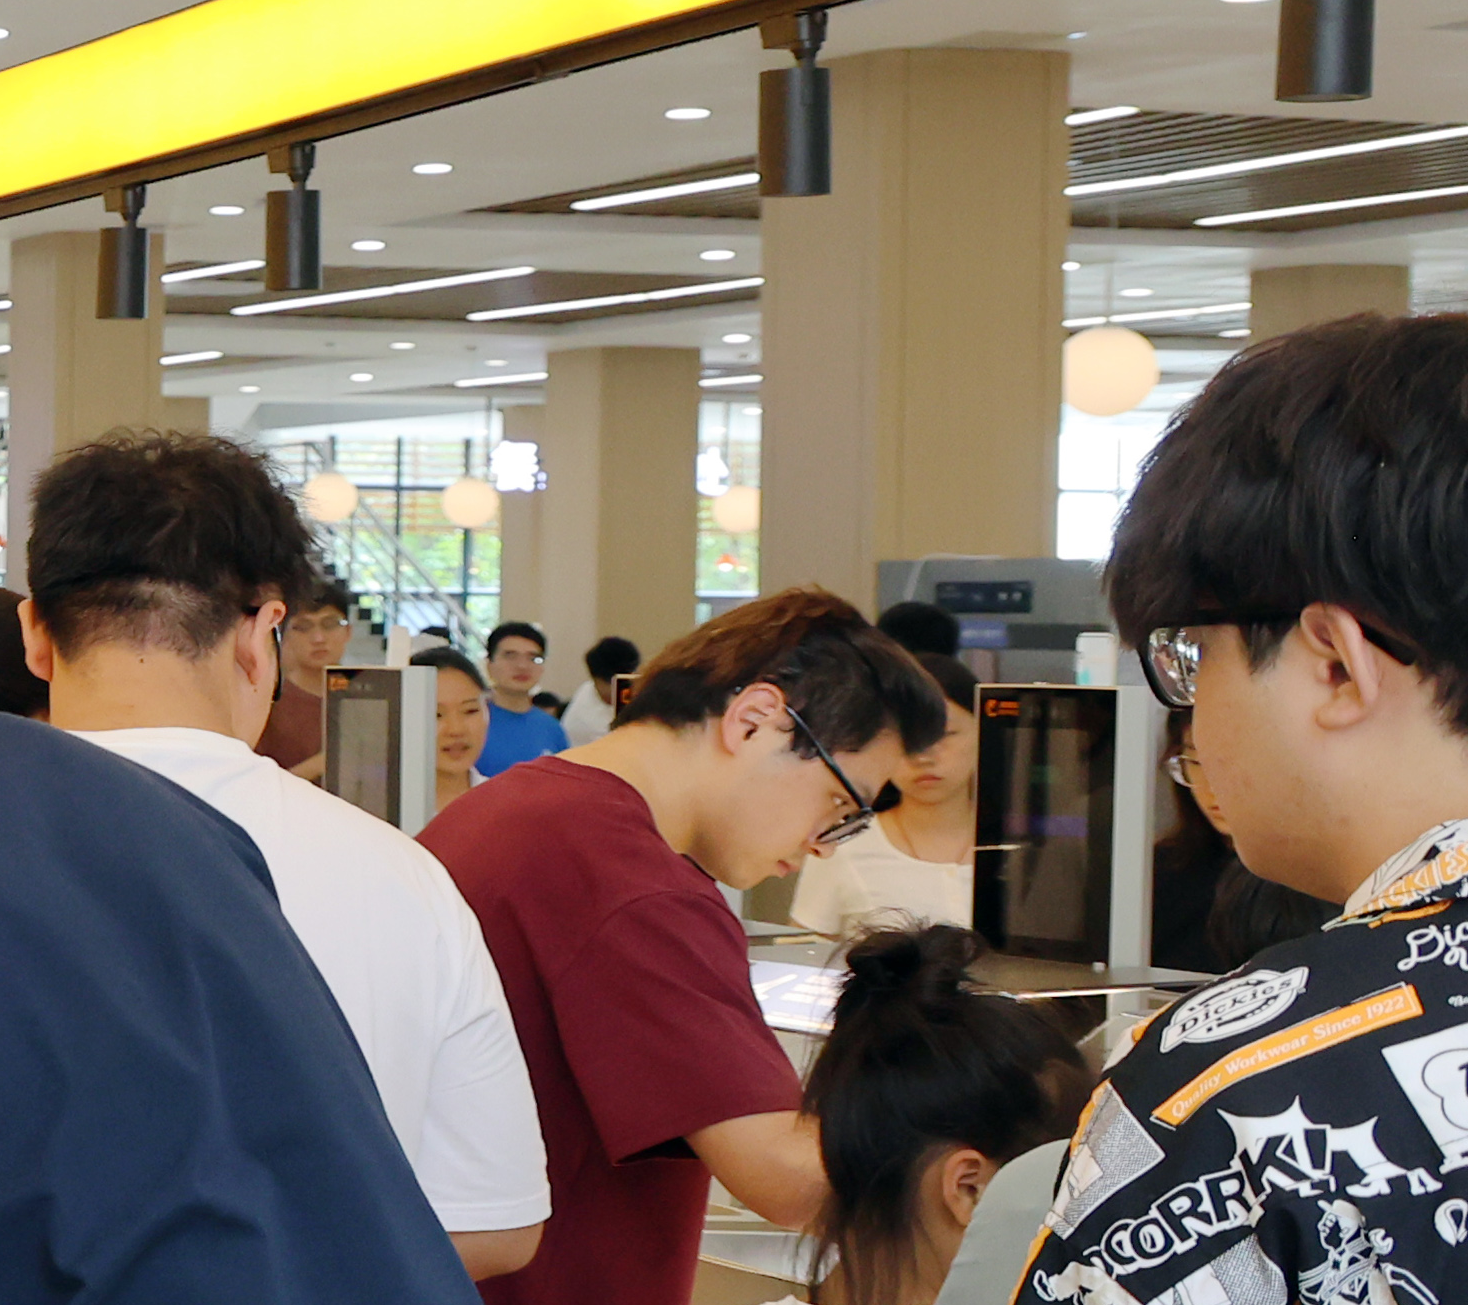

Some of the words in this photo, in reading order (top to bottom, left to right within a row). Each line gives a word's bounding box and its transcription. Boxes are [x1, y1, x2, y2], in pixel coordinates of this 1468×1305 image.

[1179, 976, 1293, 1036] Dickies
[1171, 1072, 1223, 1119] Quality
[1224, 1035, 1310, 1076] Workwear
[1312, 1012, 1363, 1041] Since
[1365, 995, 1406, 1020] 1922
